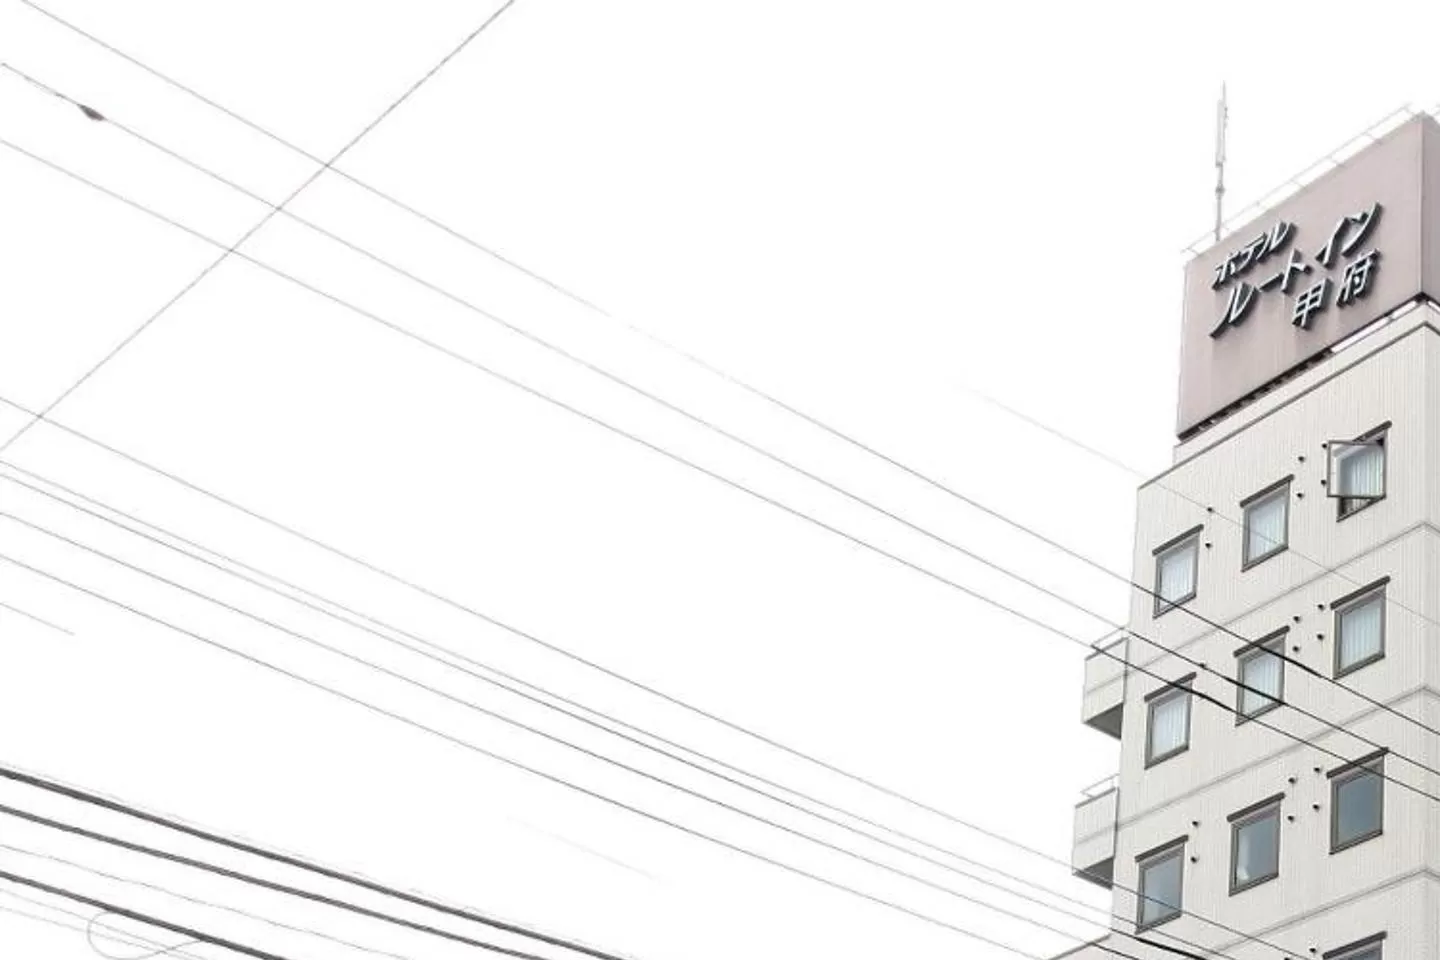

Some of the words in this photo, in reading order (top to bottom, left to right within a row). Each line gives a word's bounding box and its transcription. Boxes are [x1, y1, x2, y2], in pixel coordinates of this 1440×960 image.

[1212, 221, 1297, 290] ホテル
[1292, 249, 1381, 331] 甲府
